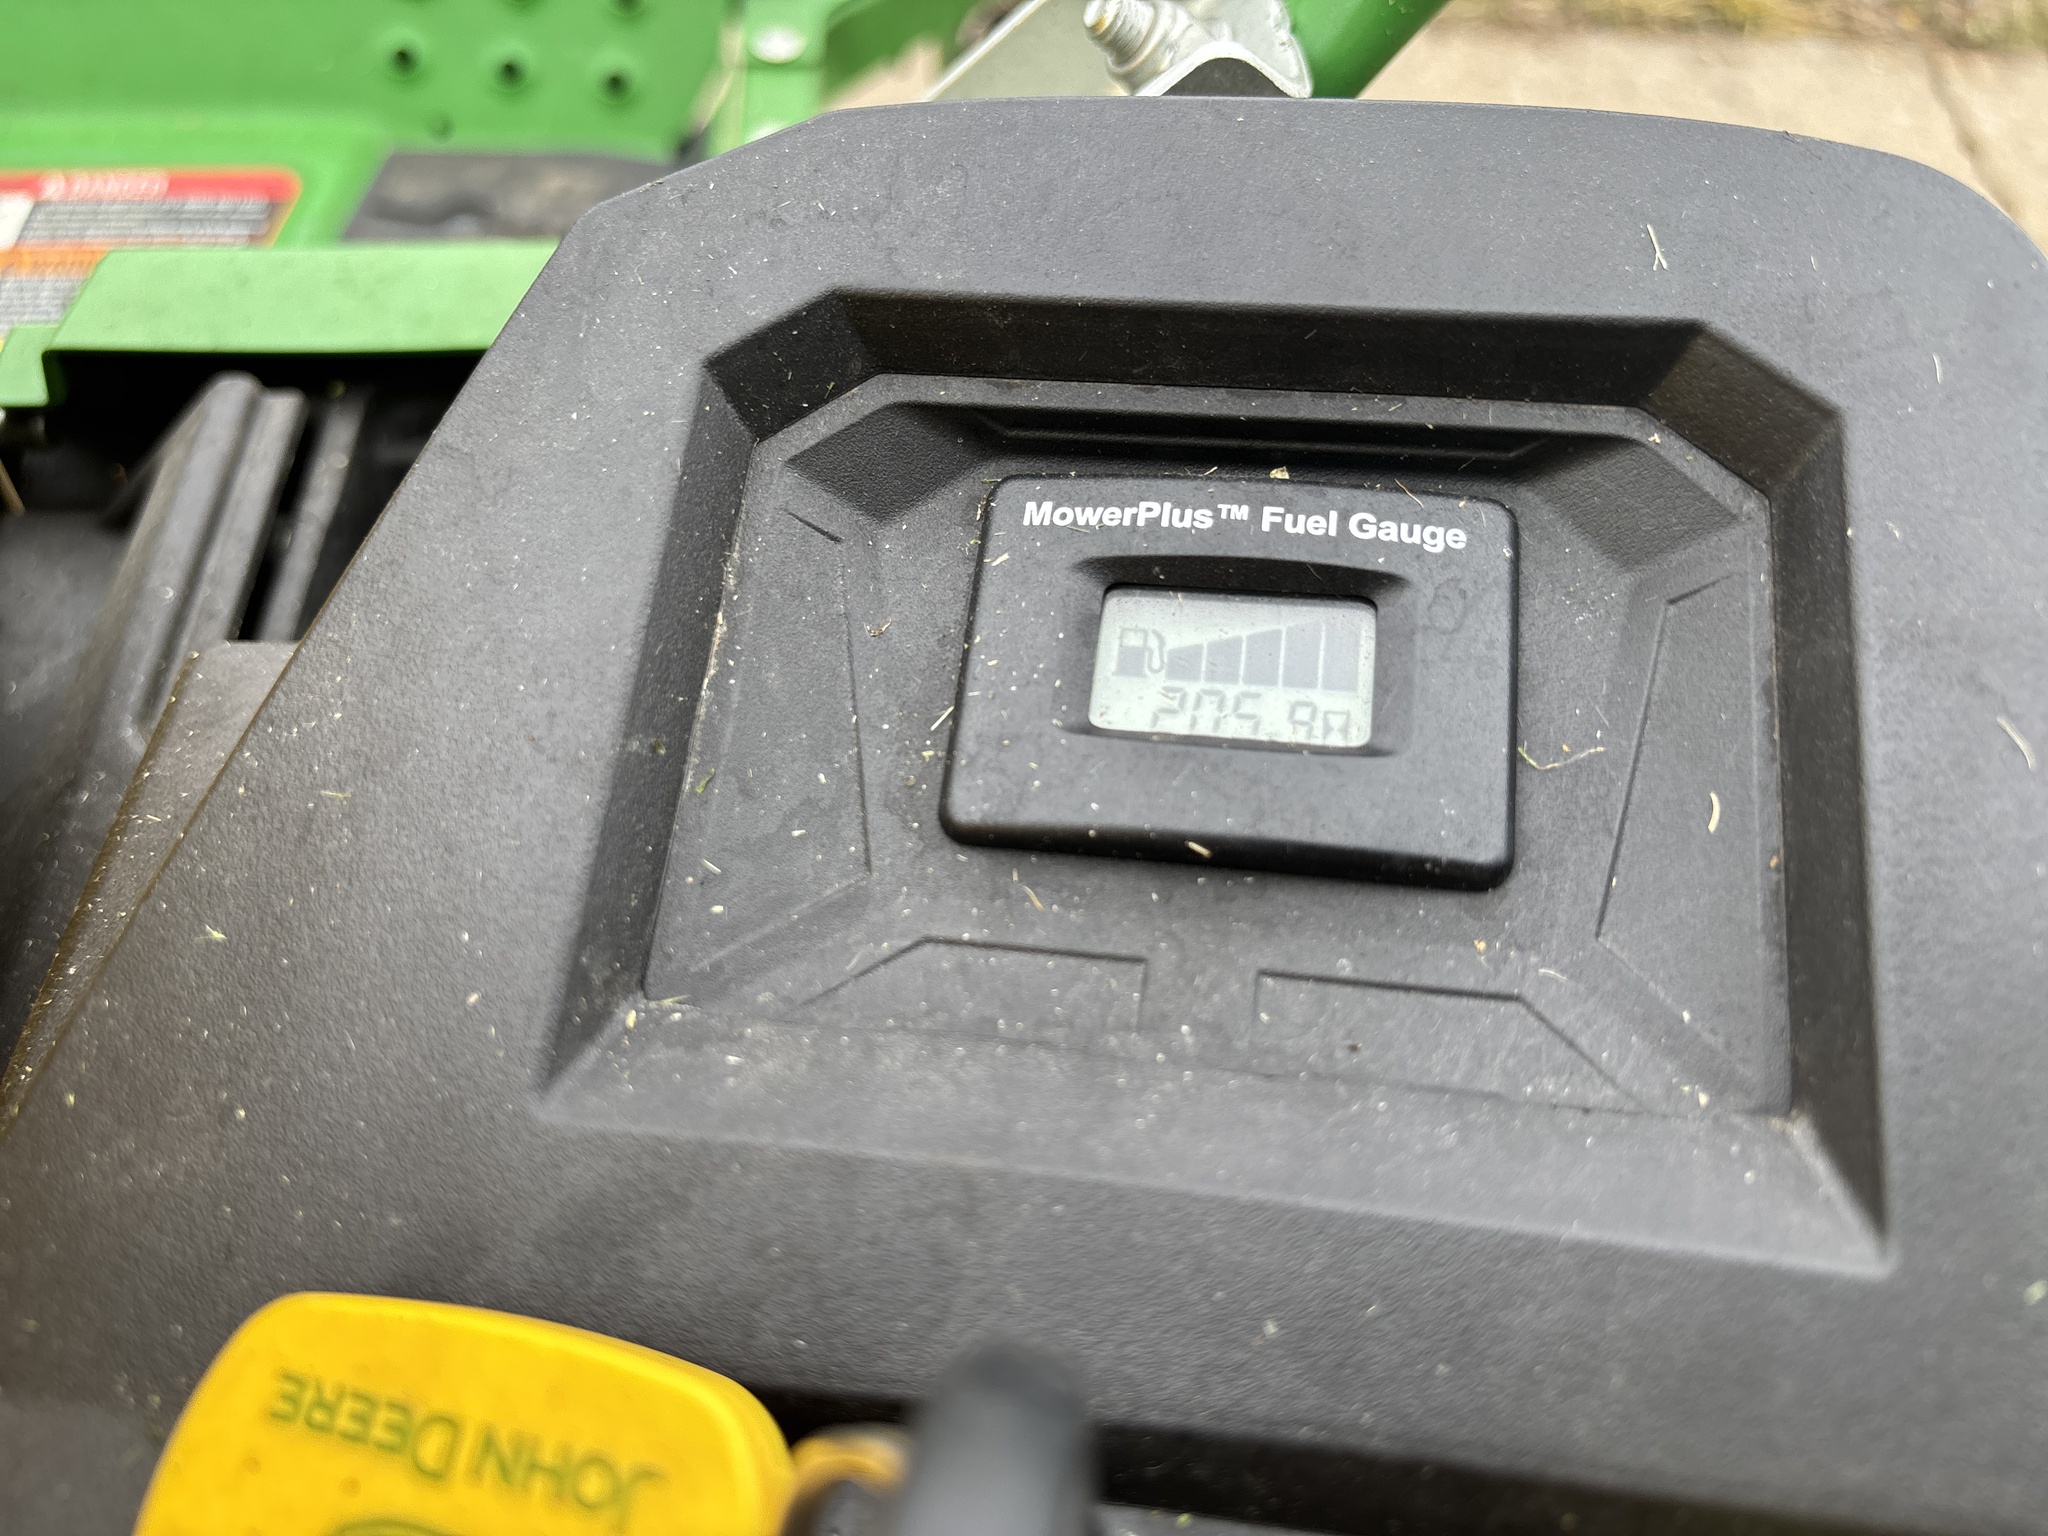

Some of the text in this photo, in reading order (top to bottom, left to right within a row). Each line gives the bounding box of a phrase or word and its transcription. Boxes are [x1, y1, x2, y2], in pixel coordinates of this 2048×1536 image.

[1261, 506, 1338, 537] Fuel
[1347, 513, 1468, 553] Gauge
[268, 1371, 668, 1532] JOHN DEERE
